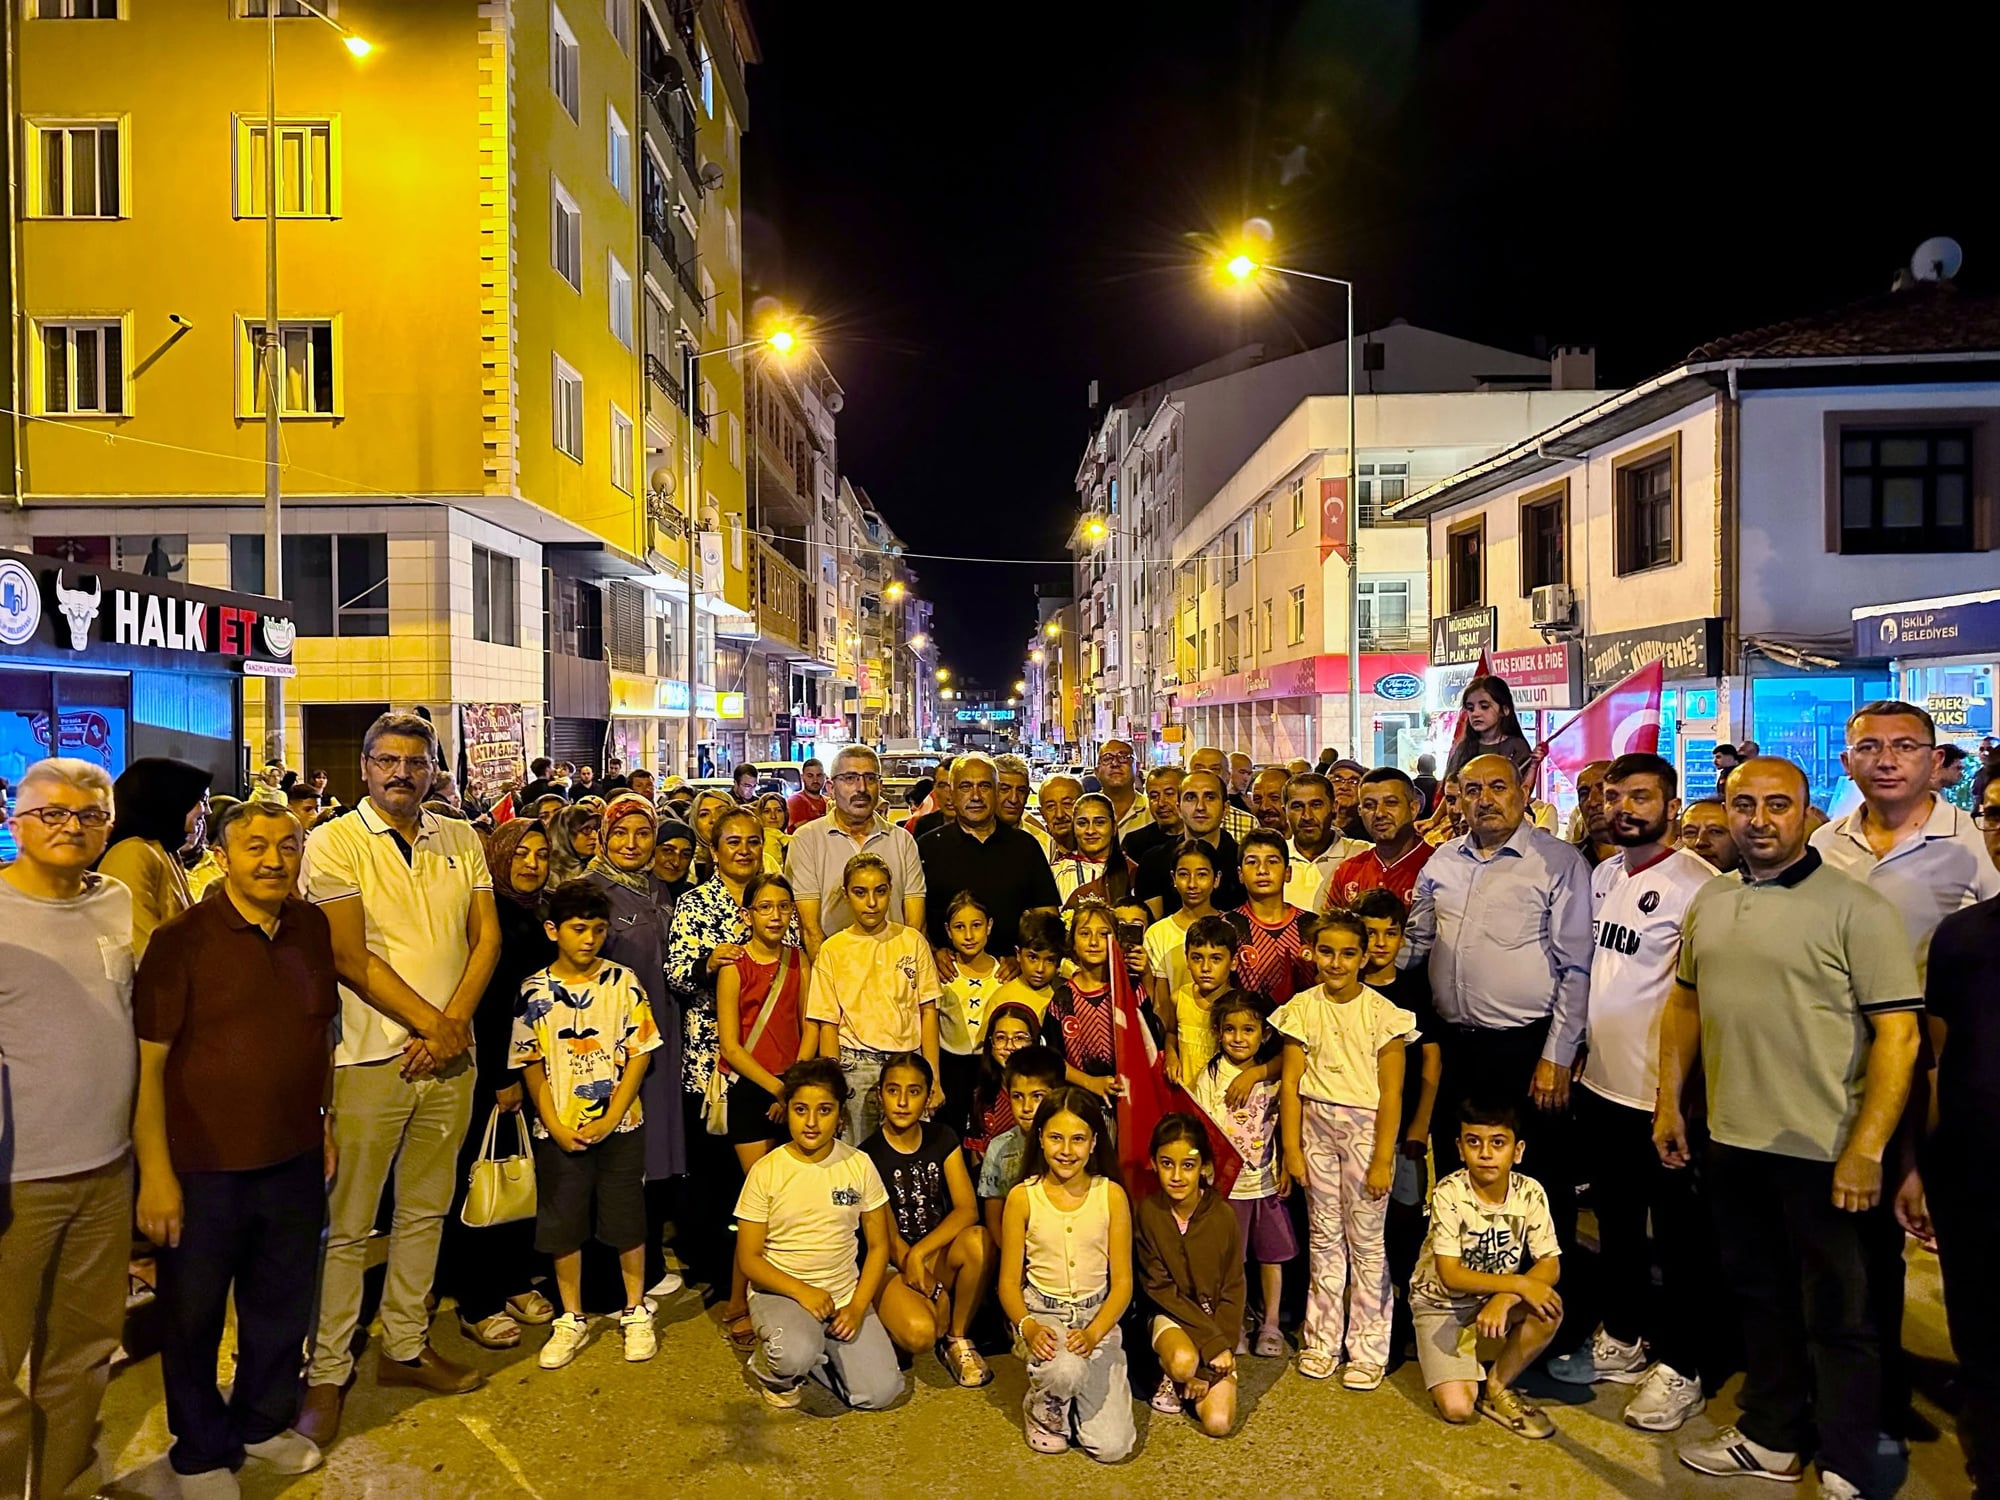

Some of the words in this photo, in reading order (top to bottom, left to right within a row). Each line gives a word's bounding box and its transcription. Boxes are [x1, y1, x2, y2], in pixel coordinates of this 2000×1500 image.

[116, 589, 206, 652] HALK
[219, 606, 257, 656] ET
[1449, 610, 1490, 632] MÜHENDİSLİK
[1901, 614, 1934, 629] İSKİLİP
[1458, 631, 1480, 649] İNŞAAT
[1901, 624, 1958, 642] BELEDİYESİ
[1450, 649, 1465, 663] PLAN
[1468, 647, 1483, 661] PRO
[1492, 659, 1510, 677] KTAŞ
[1510, 655, 1536, 673] EKMEK
[1537, 653, 1544, 670] &
[1545, 647, 1564, 670] PİDE
[1594, 641, 1624, 679] PARK
[1928, 696, 1961, 711] EMEK
[1467, 1227, 1511, 1251] THE
